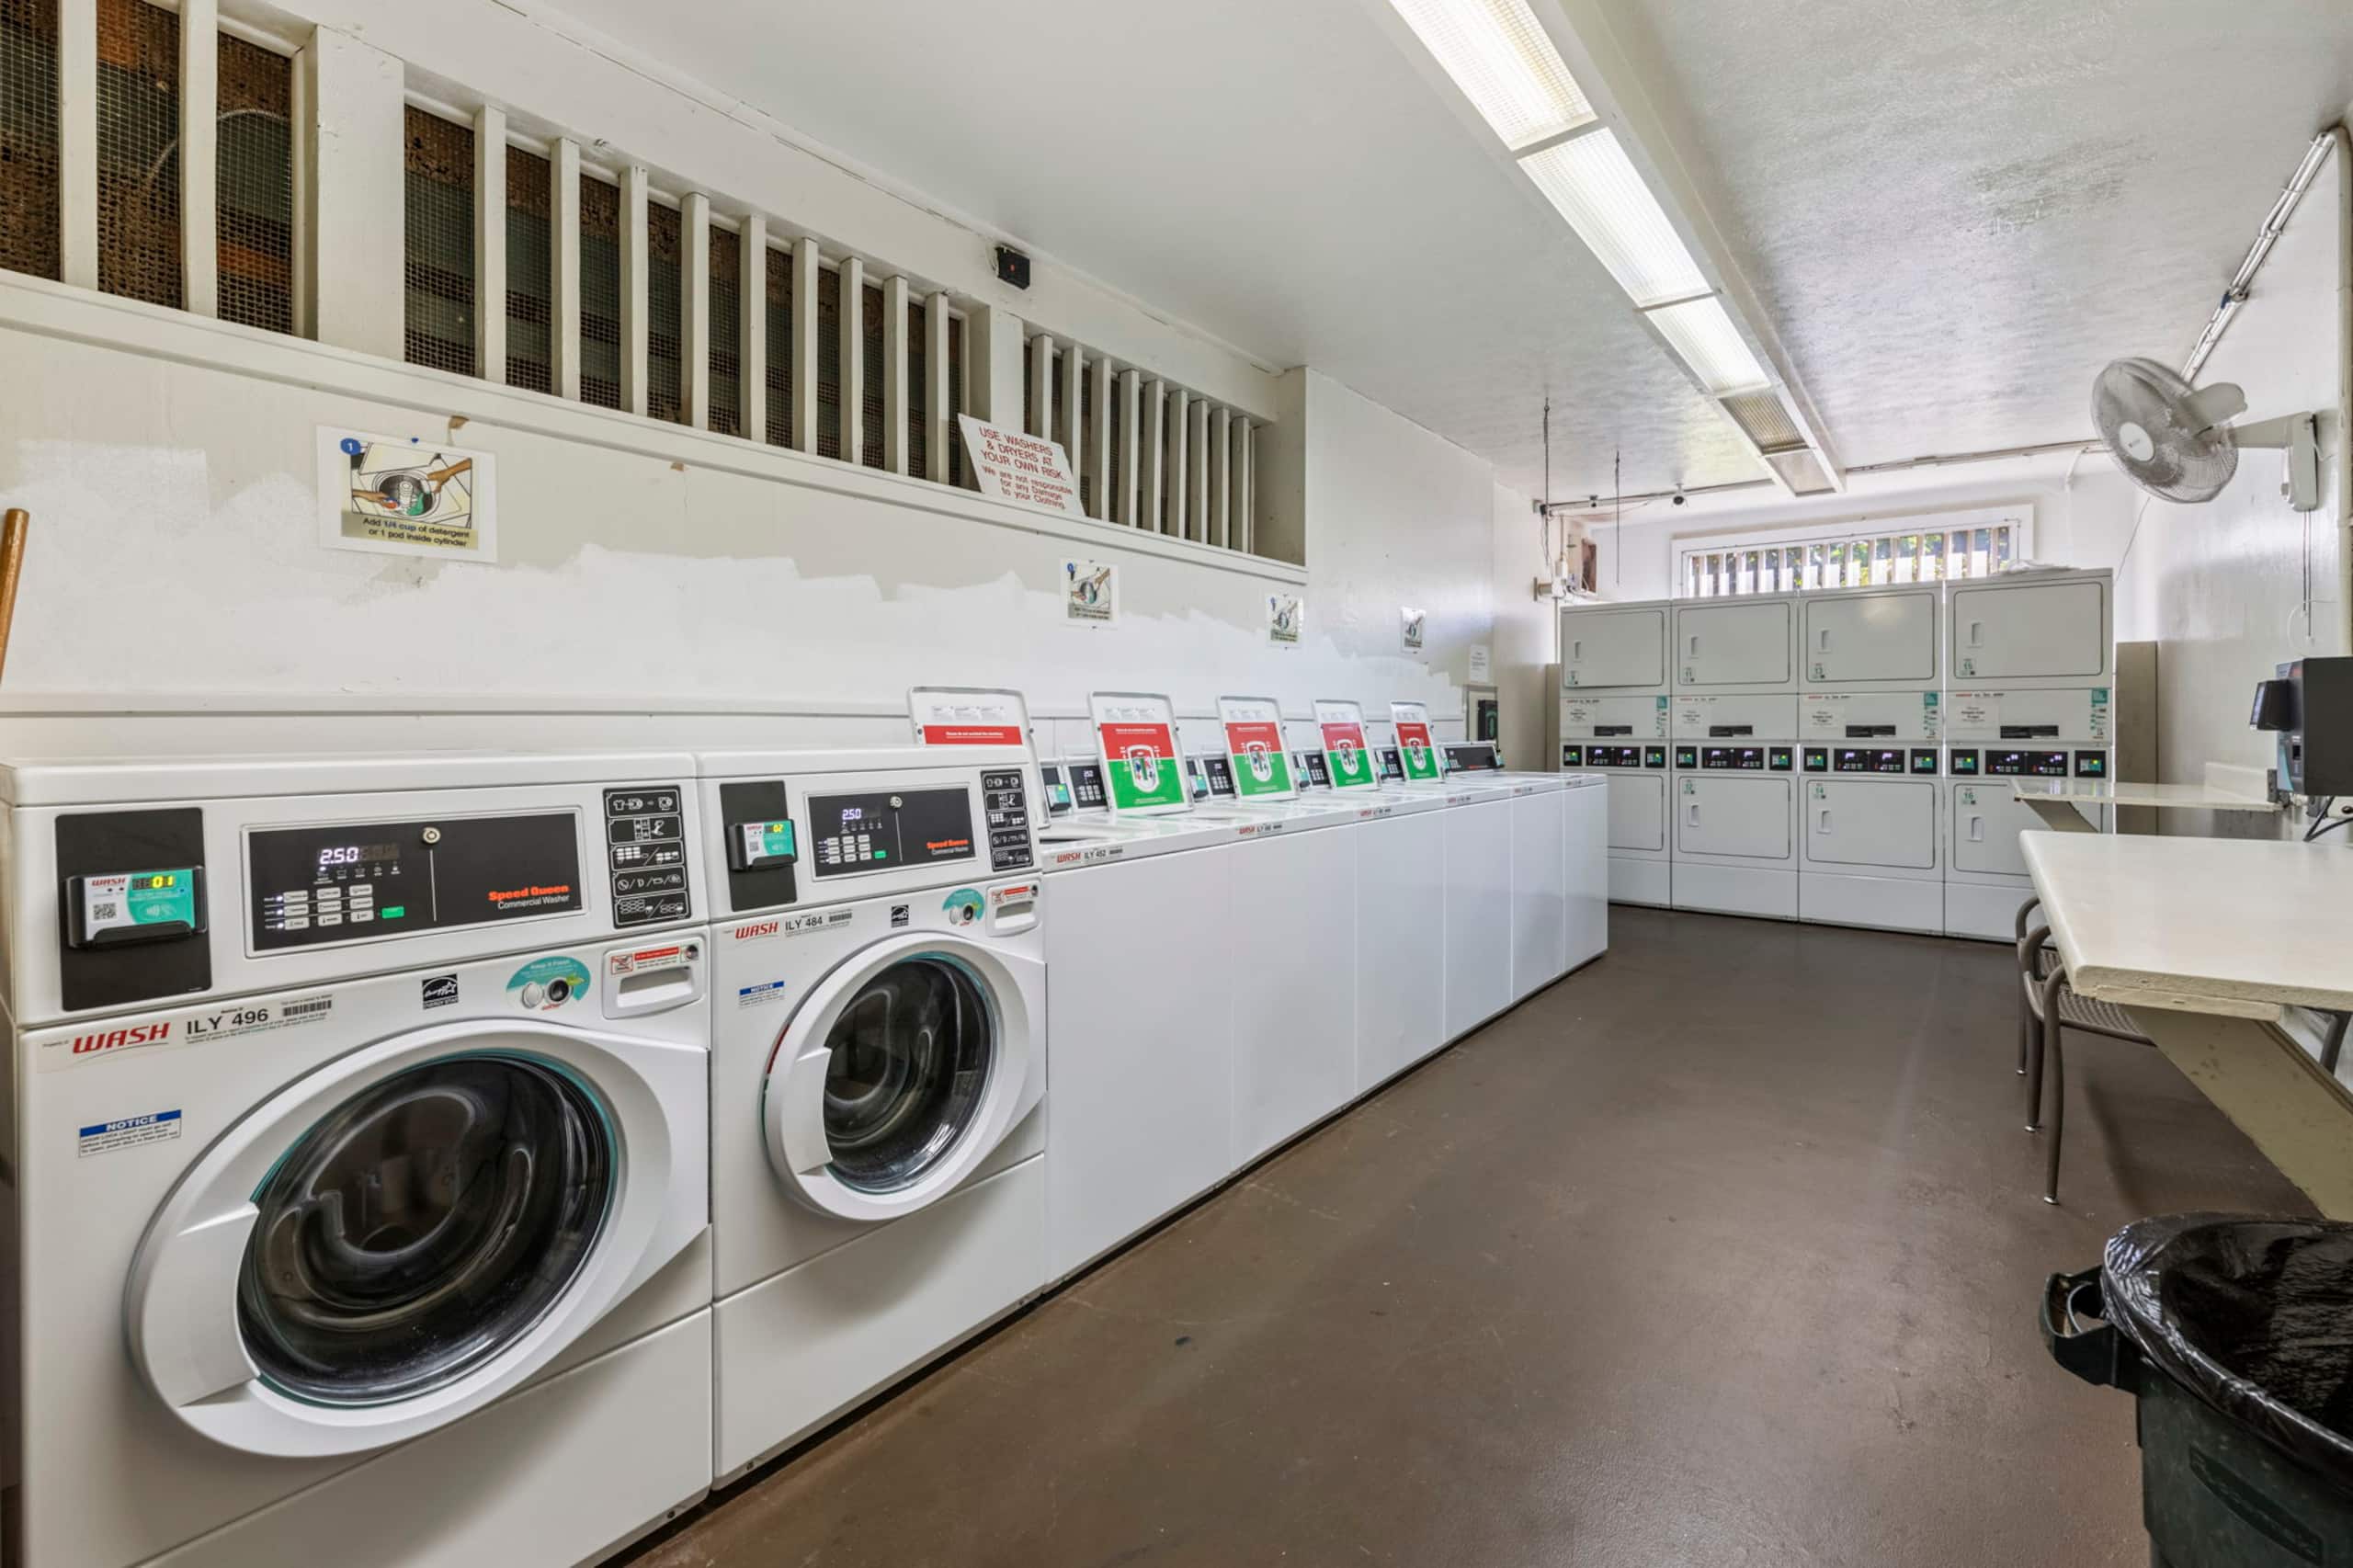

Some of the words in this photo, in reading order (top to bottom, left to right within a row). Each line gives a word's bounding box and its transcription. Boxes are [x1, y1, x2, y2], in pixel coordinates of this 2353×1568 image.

[979, 426, 1000, 441] USE
[1004, 434, 1052, 456] WASHERS
[980, 449, 1010, 465] YOUR
[1014, 459, 1039, 473] OWN
[986, 440, 994, 450] &
[998, 443, 1039, 462] DRYERS
[1042, 456, 1051, 466] AT
[982, 465, 995, 476] We
[363, 517, 381, 527] Add
[399, 523, 416, 532] cup
[428, 527, 470, 538] detergent
[388, 530, 404, 539] pod
[406, 533, 432, 542] inside
[433, 537, 467, 547] cylinder
[92, 878, 125, 886] WASH
[488, 887, 529, 901] Speed
[530, 885, 569, 895] Queen
[497, 897, 542, 910] Commercial
[542, 894, 570, 904] Washer
[735, 922, 779, 939] WASH
[785, 919, 801, 930] ILY
[805, 916, 823, 926] 484
[73, 1022, 171, 1053] WASH
[187, 1016, 222, 1034] ILY
[232, 1008, 268, 1026] 496
[106, 1115, 158, 1131] NOTICE
